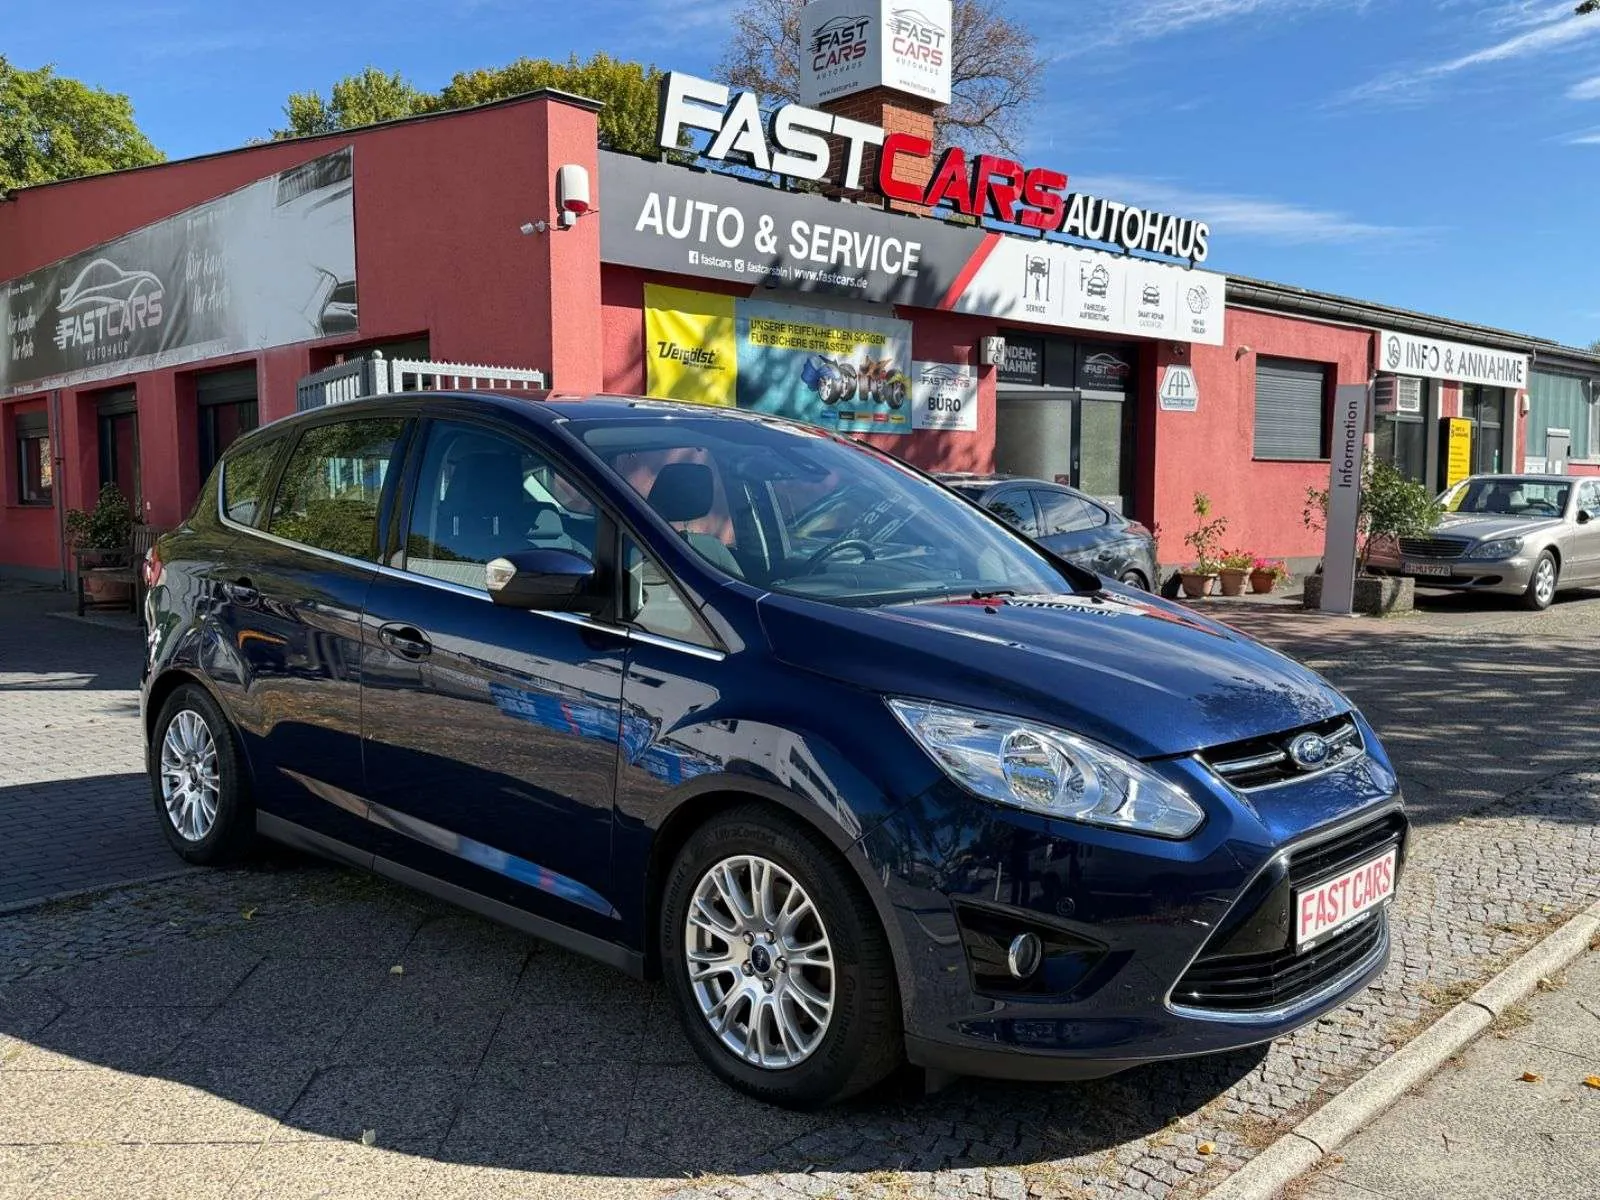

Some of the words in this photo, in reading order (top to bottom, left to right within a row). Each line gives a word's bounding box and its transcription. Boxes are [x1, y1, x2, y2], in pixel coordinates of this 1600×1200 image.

[815, 20, 870, 53] FAST
[890, 18, 945, 48] FAST
[812, 40, 867, 72] CARS
[892, 37, 943, 67] CARS
[635, 192, 745, 248] AUTO
[754, 214, 778, 255] &
[788, 220, 922, 278] SERVICE
[1063, 193, 1209, 261] AUTOHAUS
[701, 254, 732, 270] fastcars
[794, 266, 868, 289] www.fastcars.de
[54, 289, 163, 351] FASTCARS
[750, 319, 786, 334] UNSERE
[787, 324, 852, 341] REIFEN-HELDEN
[853, 331, 886, 346] SORGEN
[657, 340, 715, 365] Vergölst
[769, 334, 807, 349] SICHERE
[1405, 341, 1440, 372] INFO
[1443, 348, 1454, 374] &
[1457, 351, 1523, 383] ANNAHME
[927, 393, 962, 412] BÜRO
[1338, 400, 1358, 488] Information
[1301, 877, 1351, 936] FAST
[1352, 855, 1392, 910] CARS
